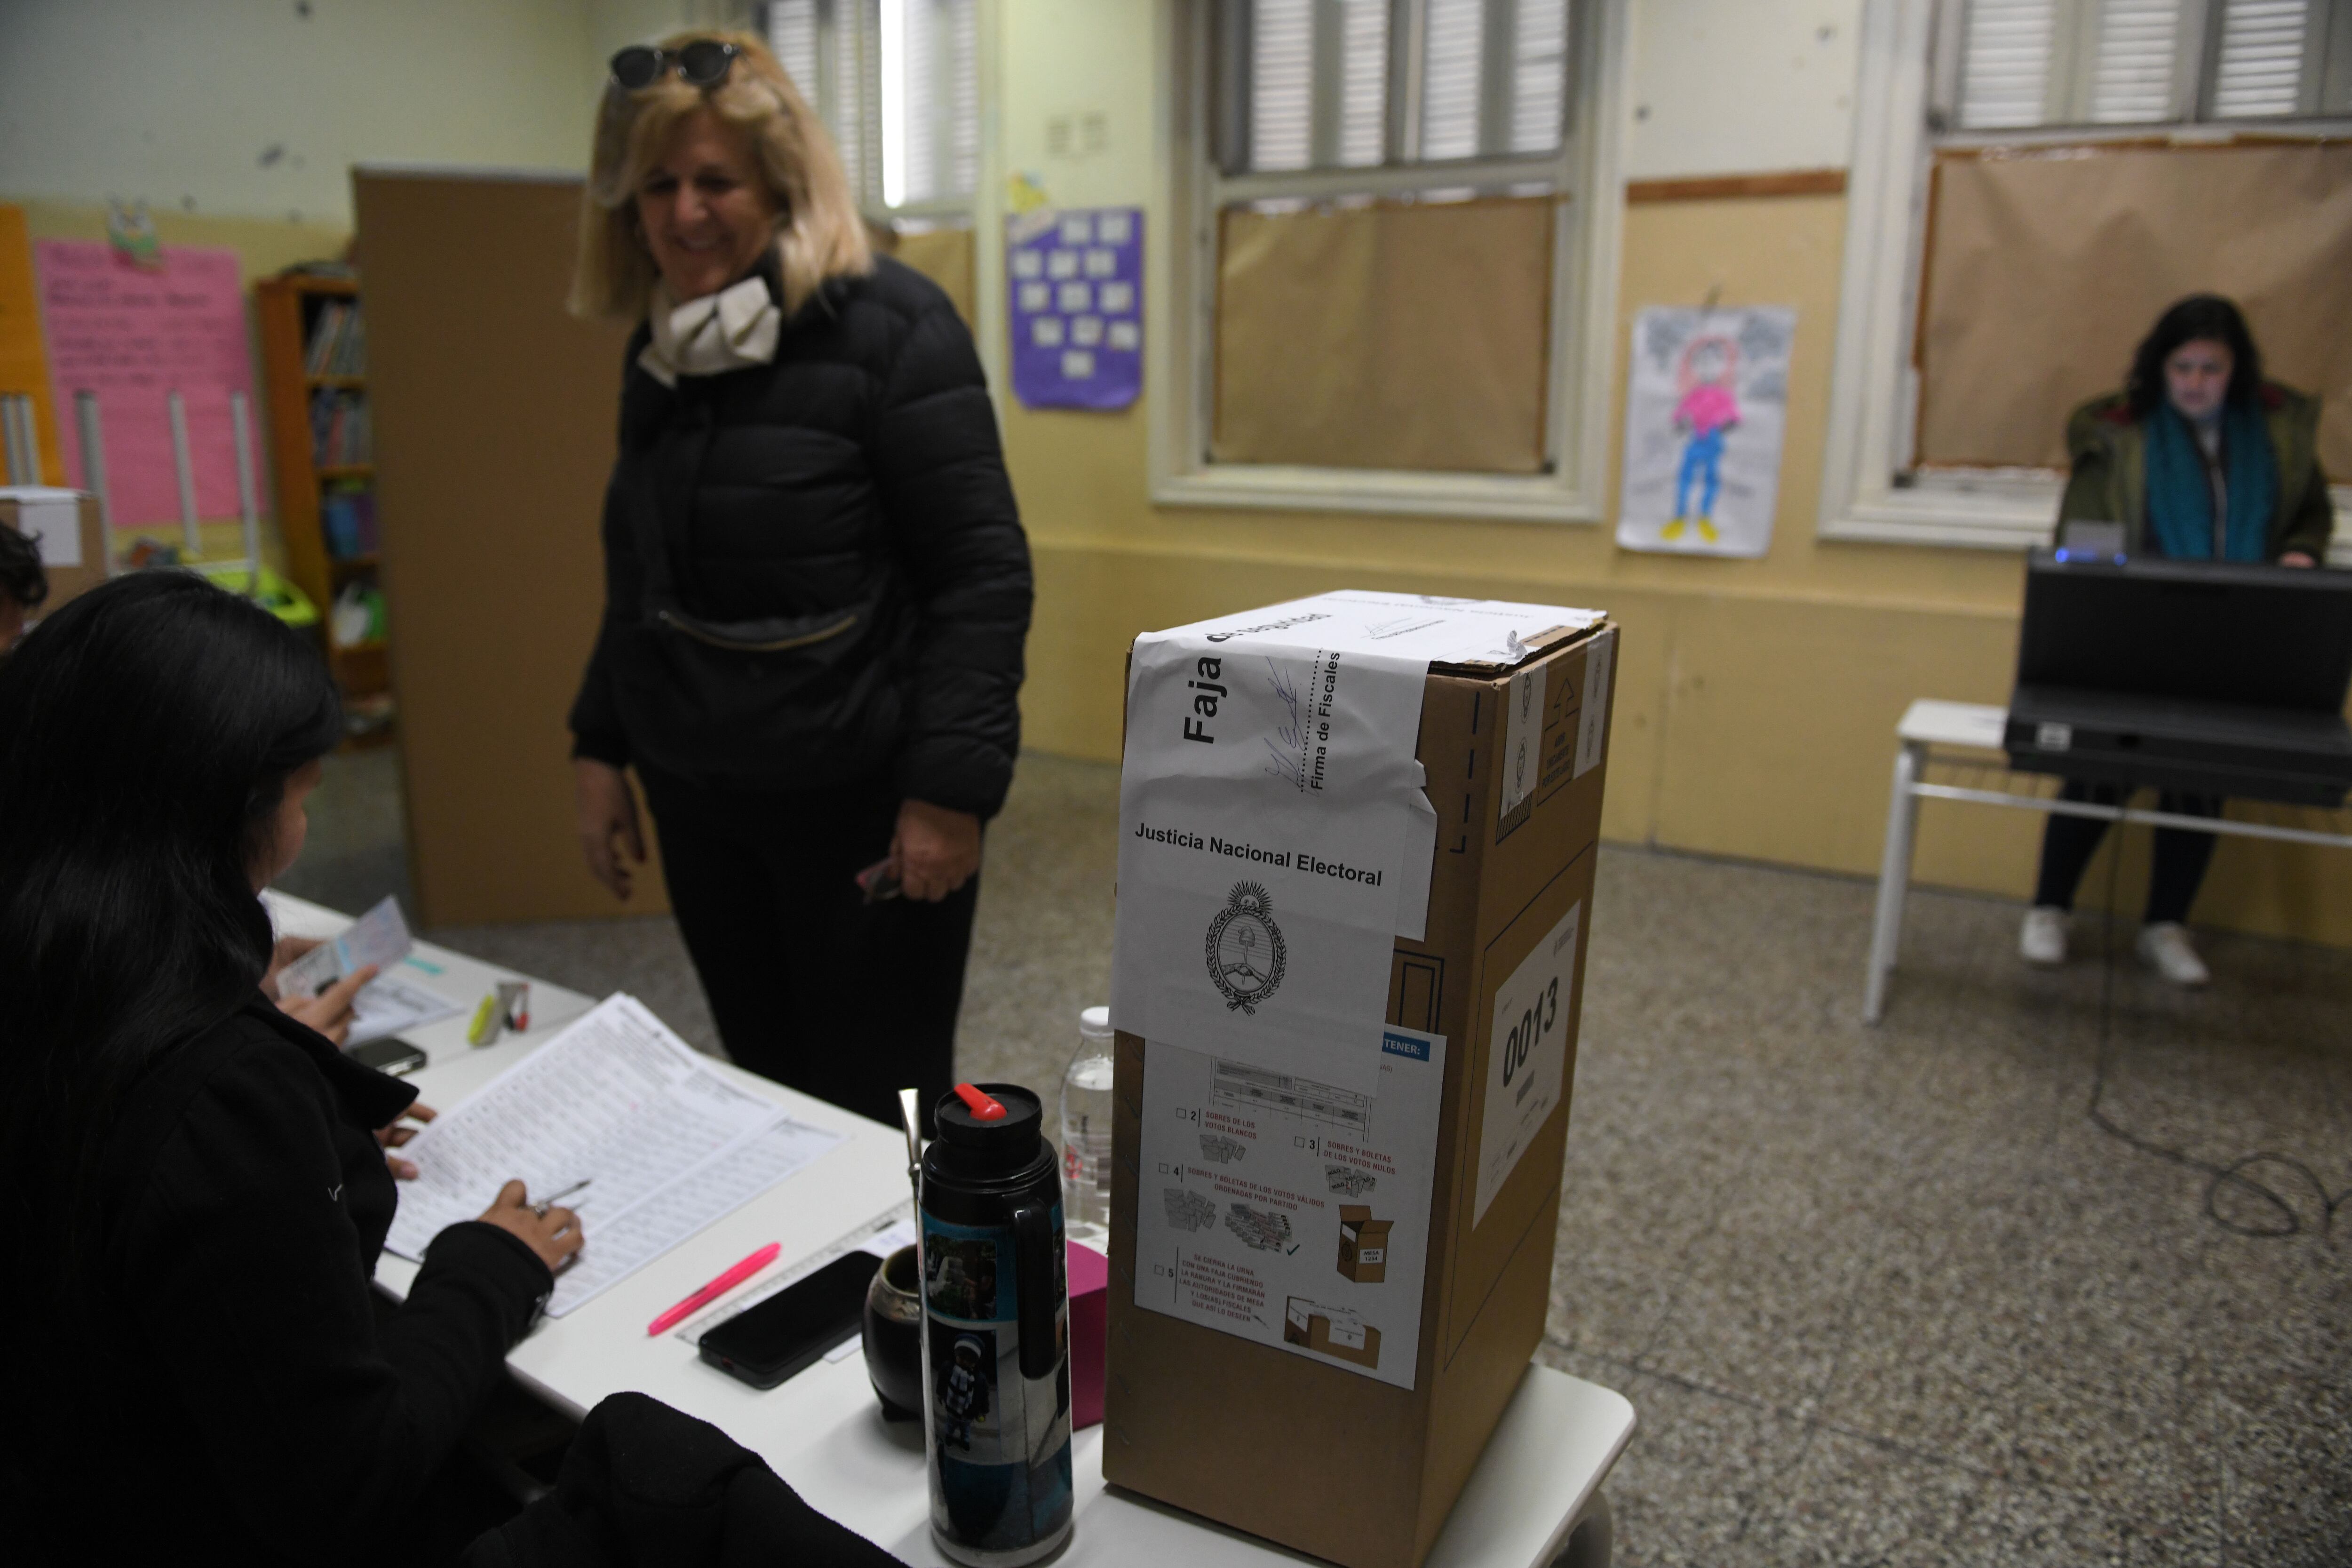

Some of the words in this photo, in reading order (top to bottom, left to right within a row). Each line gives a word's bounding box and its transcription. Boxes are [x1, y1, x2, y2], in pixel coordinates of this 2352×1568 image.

[1318, 653, 1340, 717] Fiscales
[1184, 657, 1227, 743] Faja
[1317, 722, 1329, 741] de
[1311, 746, 1326, 789] Firma
[1135, 822, 1203, 850] Justicia
[1210, 836, 1290, 867] Nacional
[1297, 854, 1382, 886] Electoral
[1503, 977, 1558, 1088] 0013
[1191, 1111, 1196, 1121] 2
[1206, 1111, 1231, 1123] SOBRES
[1243, 1120, 1255, 1129] LOS
[1205, 1121, 1225, 1131] VOTOS
[1228, 1127, 1256, 1139] BLANCOS
[1310, 1139, 1315, 1149] 3
[1327, 1141, 1353, 1153] SOBRES
[1362, 1150, 1391, 1163] BOLETAS
[1174, 1167, 1179, 1176] 4
[1335, 1153, 1346, 1162] LOS
[1349, 1157, 1370, 1168] VOTOS
[1373, 1163, 1395, 1175] NULOS
[1188, 1167, 1212, 1178] SOBRES
[1220, 1176, 1247, 1187] BOLETAS
[1259, 1185, 1271, 1194] LOS
[1273, 1189, 1295, 1200] VOTOS
[1214, 1184, 1252, 1199] ORDENADAS
[1254, 1194, 1267, 1202] POR
[1269, 1198, 1297, 1210] PARTIDO
[1168, 1268, 1173, 1277] 5
[1197, 1264, 1209, 1273] UNA
[1211, 1268, 1225, 1277] FAJA
[1228, 1273, 1263, 1288] CUBRIENDO
[1204, 1257, 1225, 1267] CIERRA
[1237, 1266, 1254, 1276] URNA
[1191, 1272, 1216, 1284] RANURA
[1192, 1282, 1235, 1298] AUTORIDADES
[1247, 1297, 1263, 1307] MESA
[1223, 1300, 1251, 1313] FISCALES
